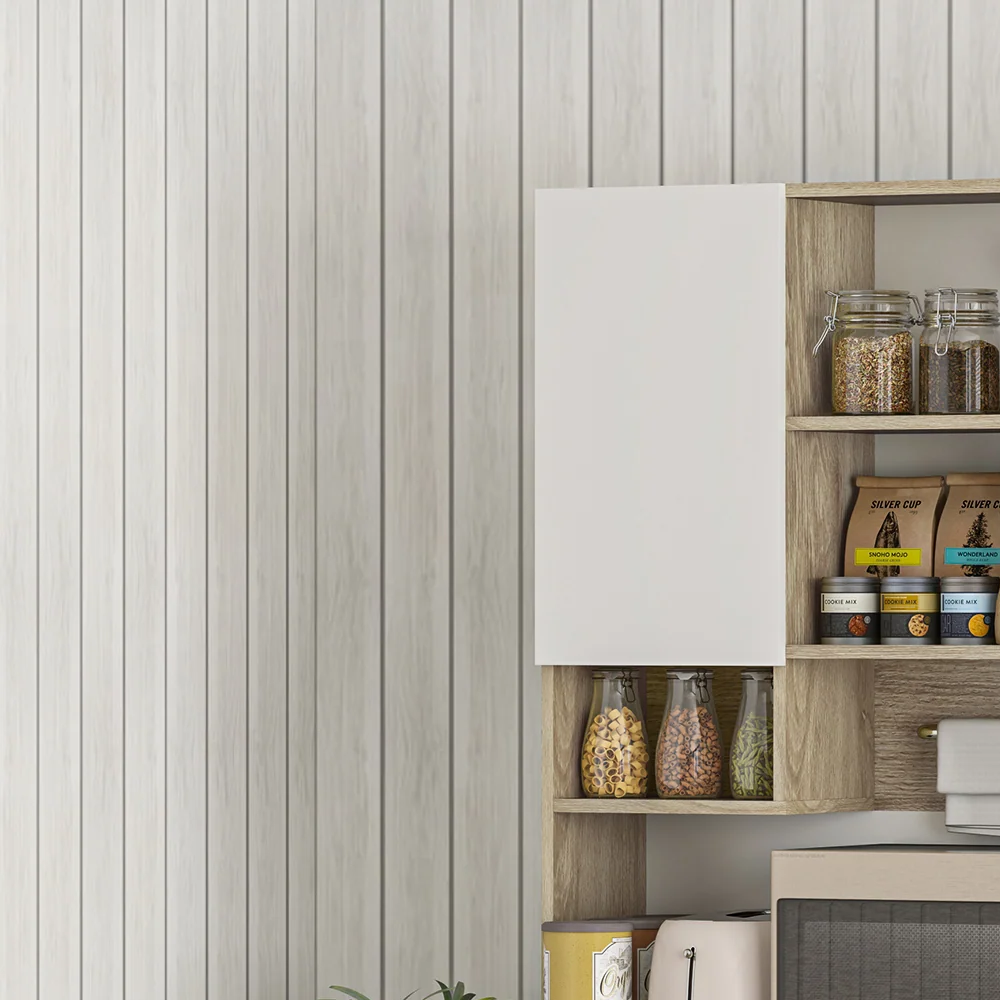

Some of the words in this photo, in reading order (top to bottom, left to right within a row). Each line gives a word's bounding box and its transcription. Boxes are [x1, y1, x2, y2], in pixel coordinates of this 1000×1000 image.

[870, 500, 901, 509] SILVER
[903, 500, 922, 509] CUP
[961, 500, 991, 509] SILVER
